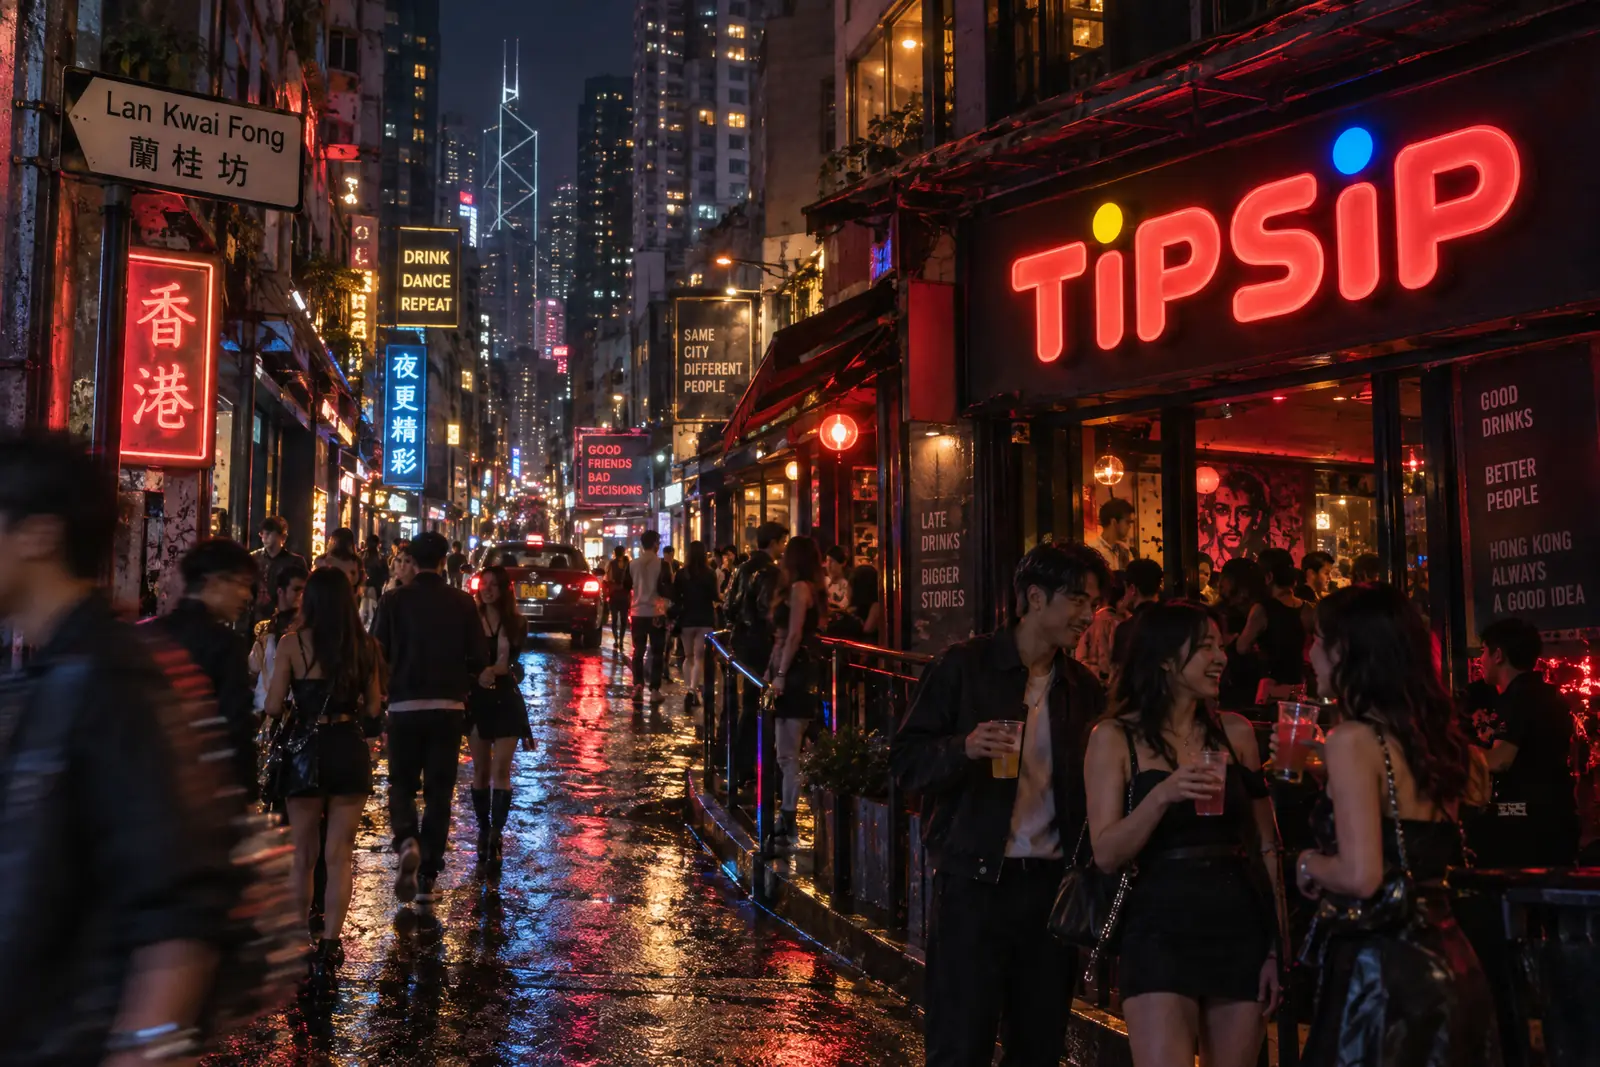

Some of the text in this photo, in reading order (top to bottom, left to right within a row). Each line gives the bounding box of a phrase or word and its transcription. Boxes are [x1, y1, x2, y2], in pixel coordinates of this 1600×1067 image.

[106, 90, 284, 153] Lan Kwai Fong
[128, 135, 250, 187] 蘭桂坊
[403, 249, 450, 265] DRINK
[402, 273, 451, 289] DANCE
[401, 296, 453, 312] REPEAT
[684, 328, 715, 342] SAME
[132, 282, 197, 430] 香港
[684, 345, 709, 359] CITY
[684, 362, 743, 376] DIFFERENT
[684, 379, 726, 393] PEOPLE
[1480, 384, 1519, 411] GOOD
[391, 352, 420, 476] 夜更精彩
[1481, 407, 1533, 438] DRINKS
[587, 444, 622, 456] GOOD
[587, 458, 633, 469] FRIENDS
[1485, 457, 1537, 487] BETTER
[587, 471, 611, 483] BAD
[587, 484, 643, 496] DECISIONS
[1486, 484, 1539, 512] PEOPLE
[921, 510, 948, 530] LATE
[921, 532, 960, 552] DRINKS
[1489, 530, 1573, 563] HONG KONG
[921, 566, 960, 586] BIGGER
[1491, 560, 1547, 587] ALWAYS
[921, 588, 965, 610] STORIES
[1493, 583, 1586, 613] A GOOD IDEA
